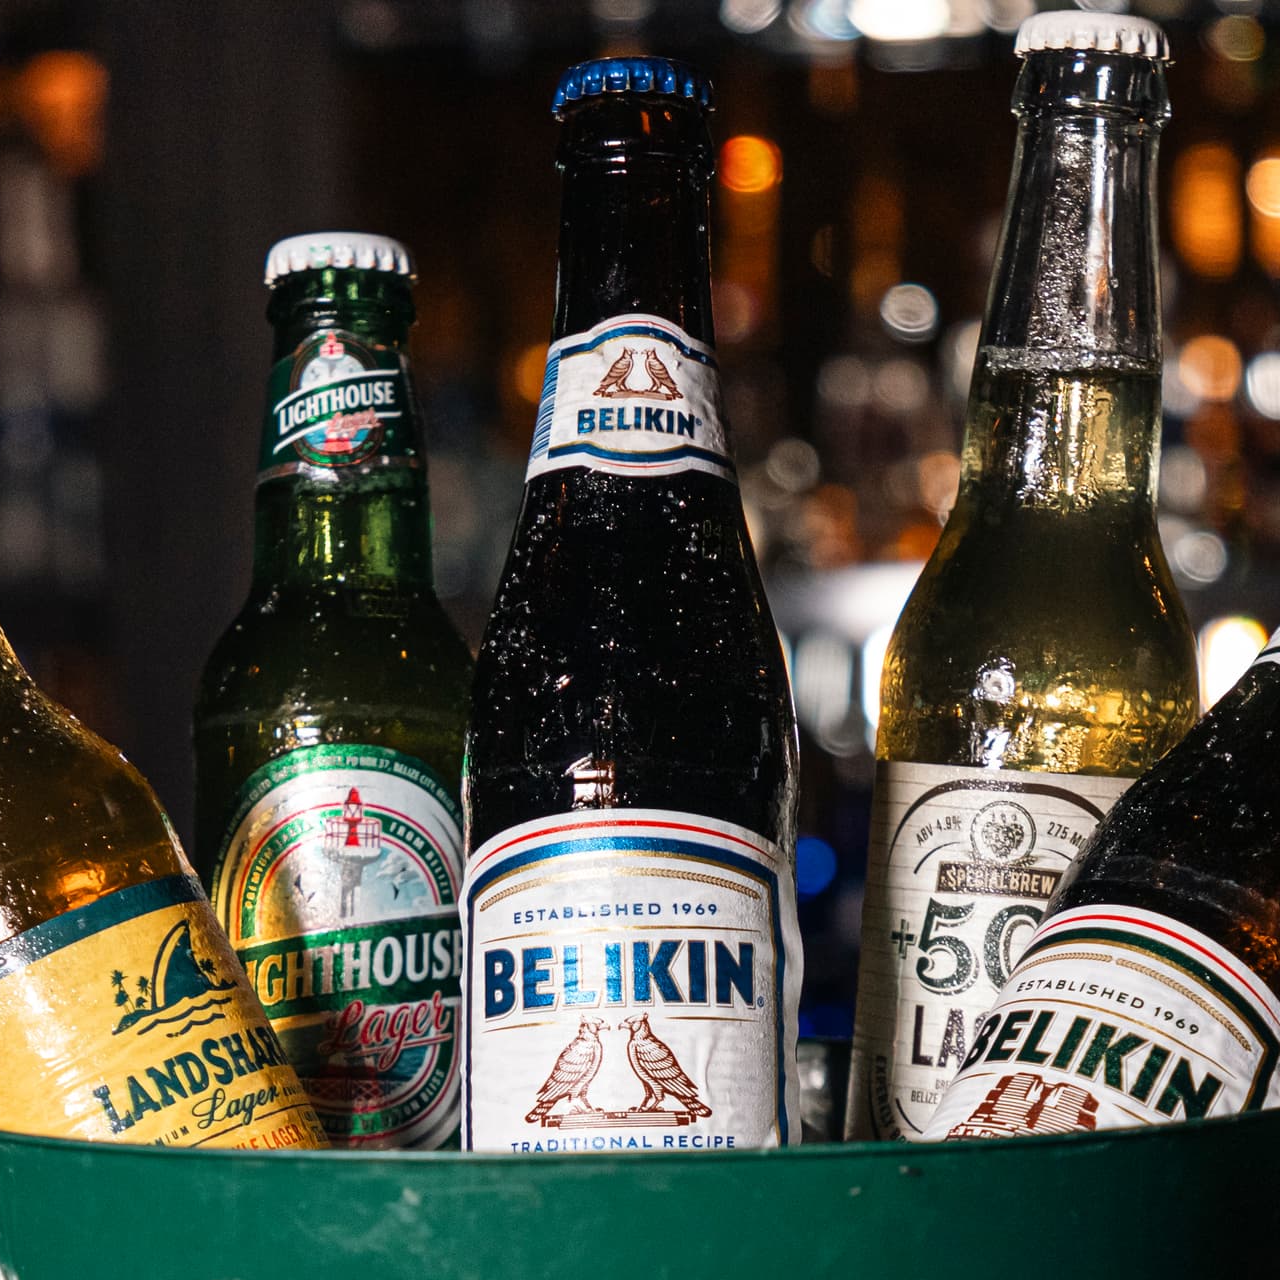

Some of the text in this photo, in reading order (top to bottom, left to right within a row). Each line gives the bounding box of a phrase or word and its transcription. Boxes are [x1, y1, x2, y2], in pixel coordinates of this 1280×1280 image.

[279, 382, 395, 435] LIGHTHOUSE
[577, 407, 695, 438] BELIKIN
[389, 821, 425, 850] FROM
[915, 823, 933, 846] ABV
[1047, 821, 1068, 840] 275
[1009, 869, 1056, 895] BREW
[513, 902, 718, 924] ESTABLISHED 1969
[483, 938, 756, 1022] BELIKIN
[1016, 979, 1200, 1035] ESTABLISHED 1969
[320, 989, 452, 1072] Lager
[958, 1008, 1224, 1122] BELIKIN
[192, 1087, 279, 1130] Lager
[911, 1089, 938, 1105] BELIZE
[263, 1124, 305, 1150] LAGER
[511, 1135, 736, 1153] TRADITIONAL RECIPE
